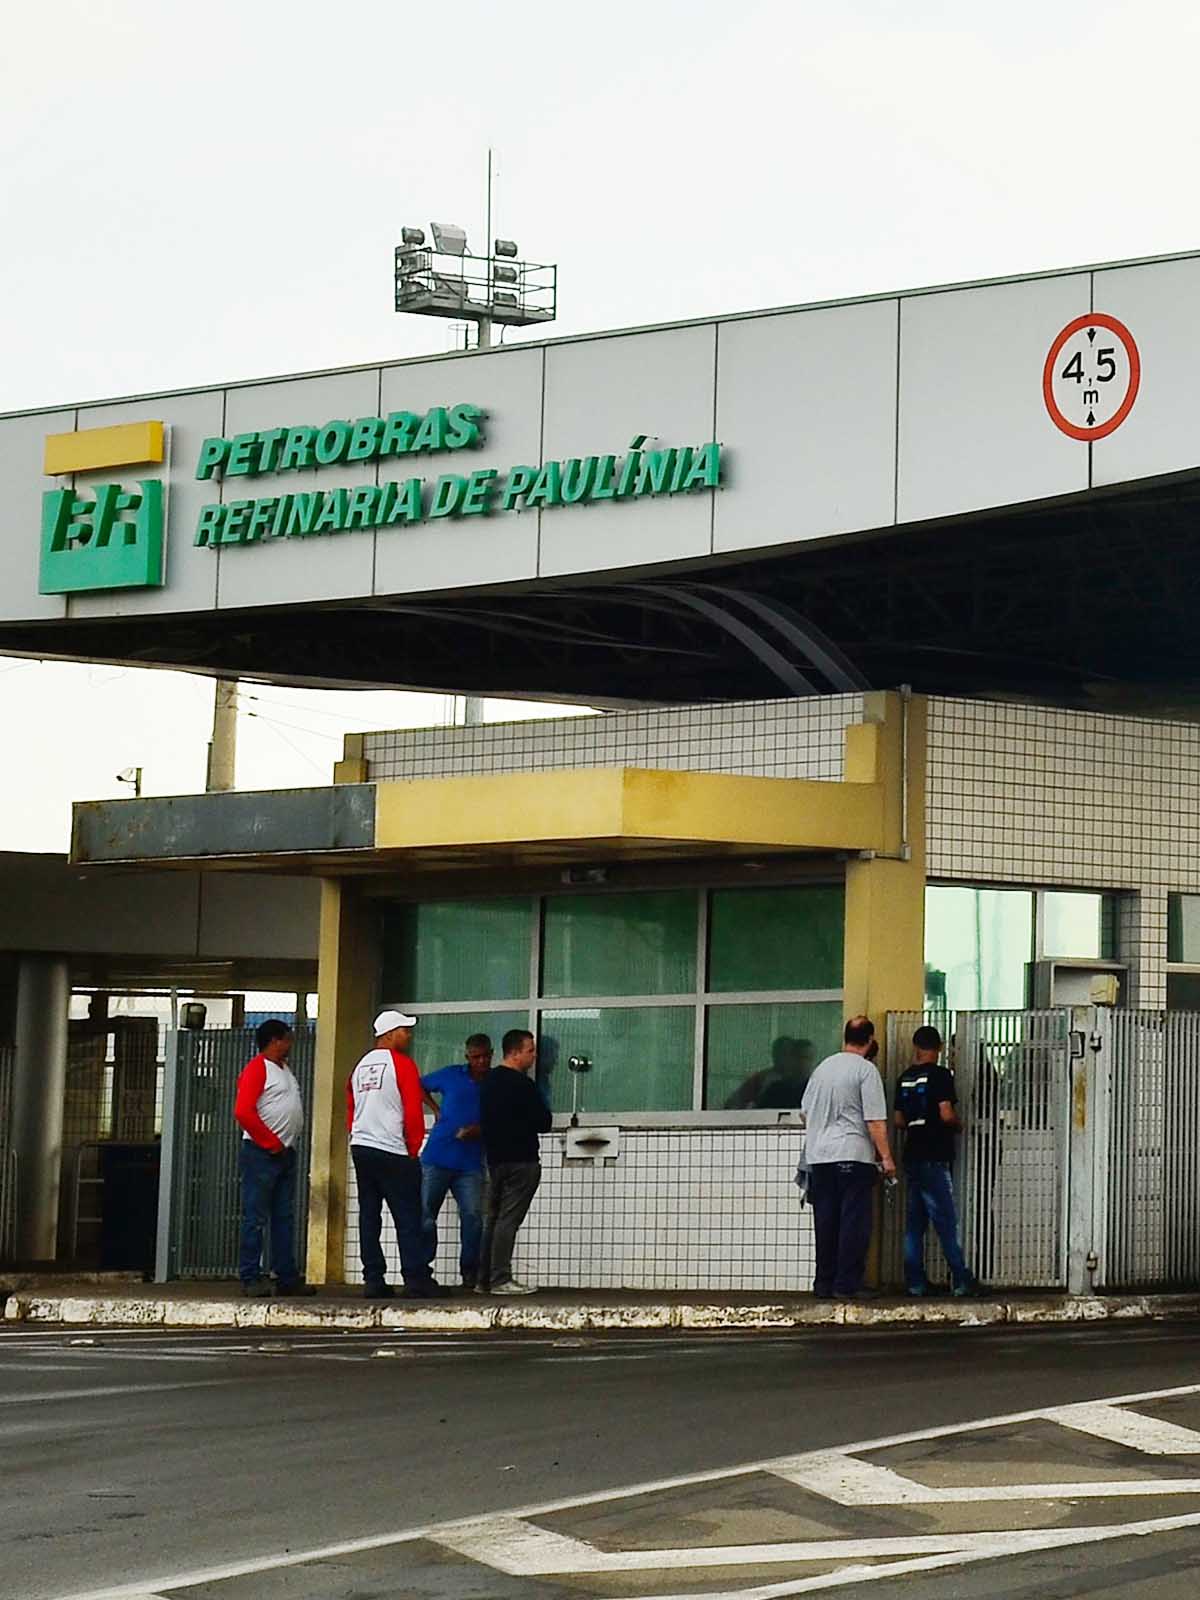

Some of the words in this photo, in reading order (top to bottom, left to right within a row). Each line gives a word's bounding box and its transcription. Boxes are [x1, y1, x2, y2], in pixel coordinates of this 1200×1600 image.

[1062, 348, 1116, 387] 4,5
[1083, 389, 1099, 405] m
[195, 403, 482, 481] PETROBRAS
[193, 478, 422, 547] REFINARIA
[429, 468, 499, 519] DE
[503, 433, 721, 511] PAULÍNIA
